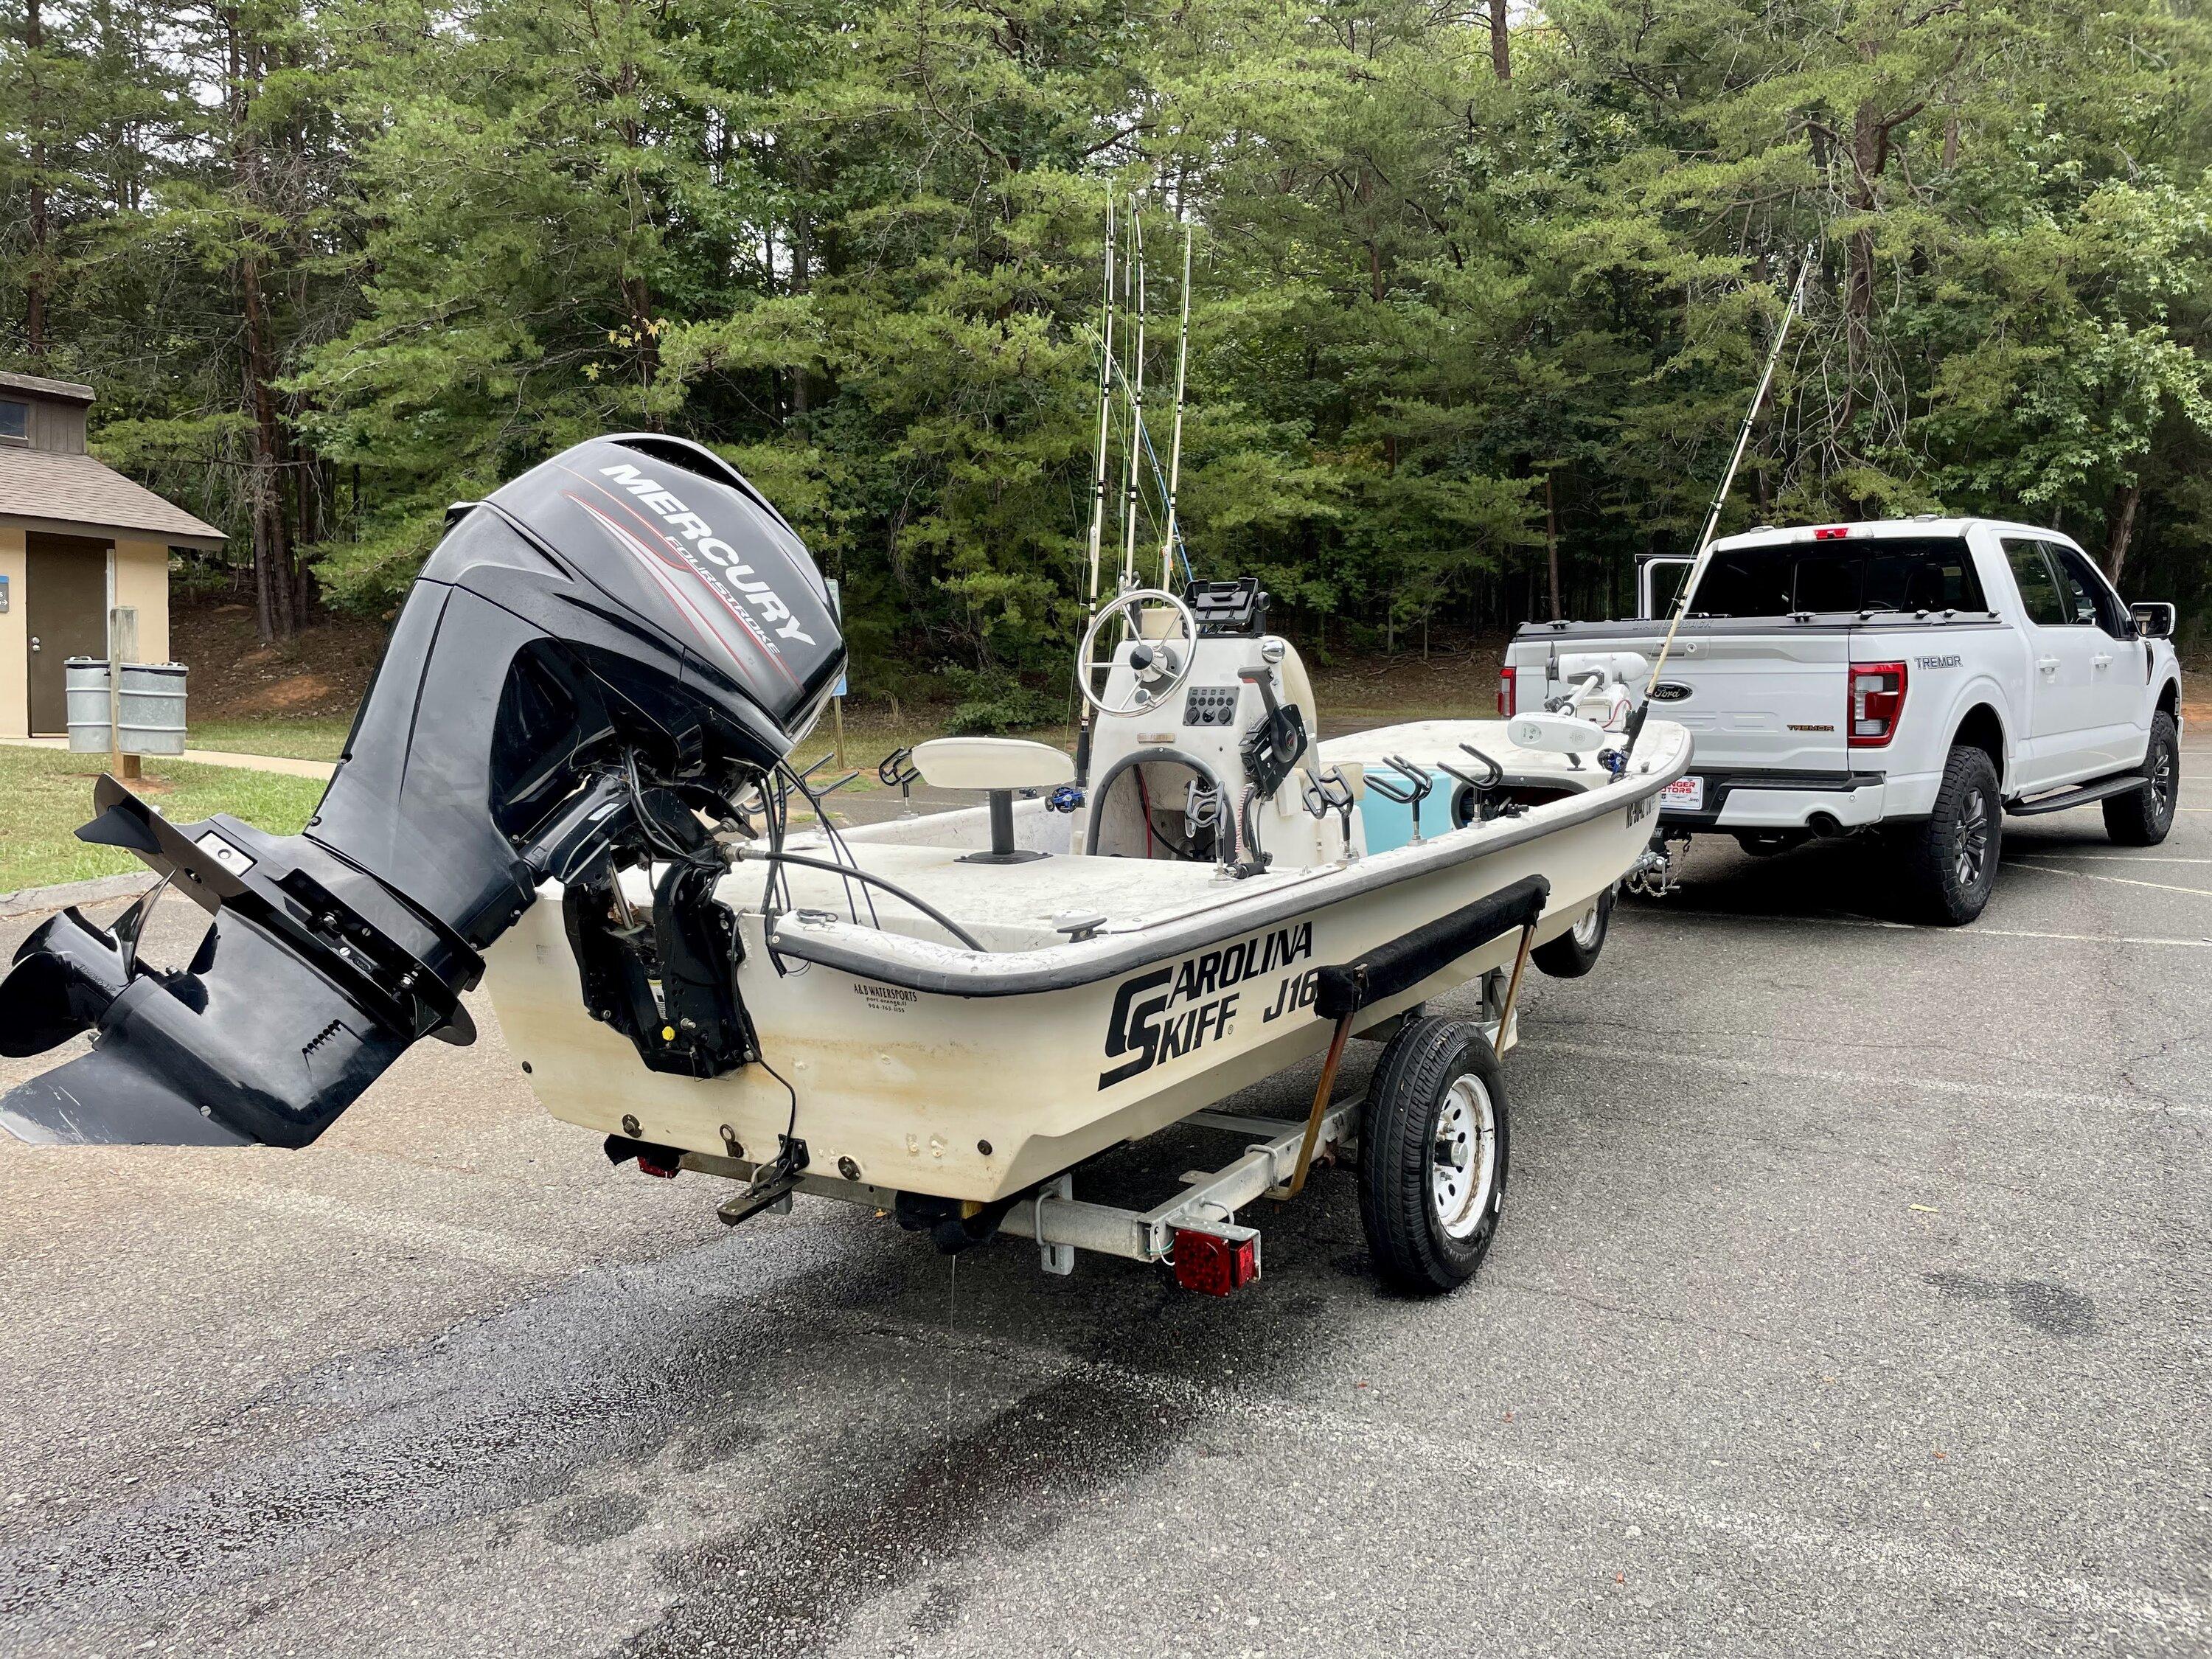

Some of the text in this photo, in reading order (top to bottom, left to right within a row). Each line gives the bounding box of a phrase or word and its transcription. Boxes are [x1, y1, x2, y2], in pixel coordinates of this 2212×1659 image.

[599, 464, 816, 645] MERCURY
[664, 536, 780, 655] FOURSTROKE
[1654, 685, 1681, 698] Ford
[1913, 655, 1964, 669] TREMOR
[869, 985, 917, 1001] WATERSPORTS
[1105, 921, 1312, 1058] CAROLINA
[1263, 967, 1318, 1023] J16
[1097, 992, 1240, 1091] SKIFF
